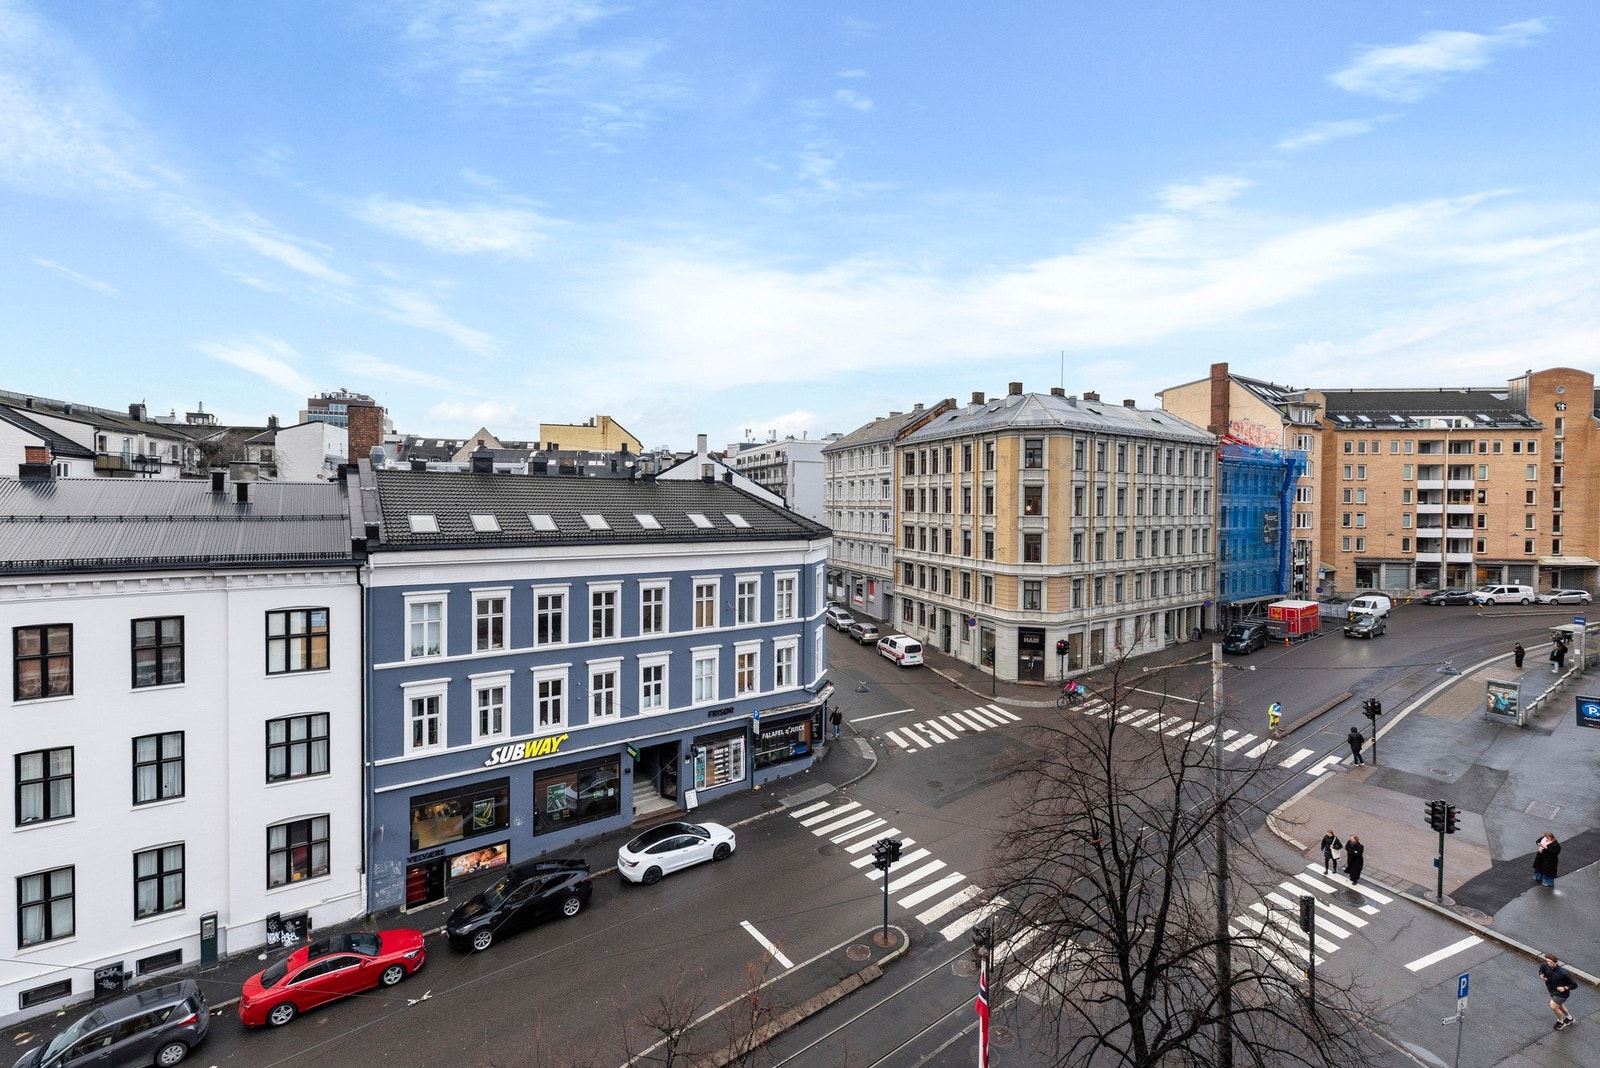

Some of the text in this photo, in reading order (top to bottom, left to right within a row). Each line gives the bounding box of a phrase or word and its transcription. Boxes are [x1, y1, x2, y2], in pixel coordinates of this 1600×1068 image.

[762, 729, 785, 739] FALAFEL
[790, 724, 805, 733] JUICE
[484, 733, 569, 767] SUBWAY
[1460, 977, 1467, 996] P
